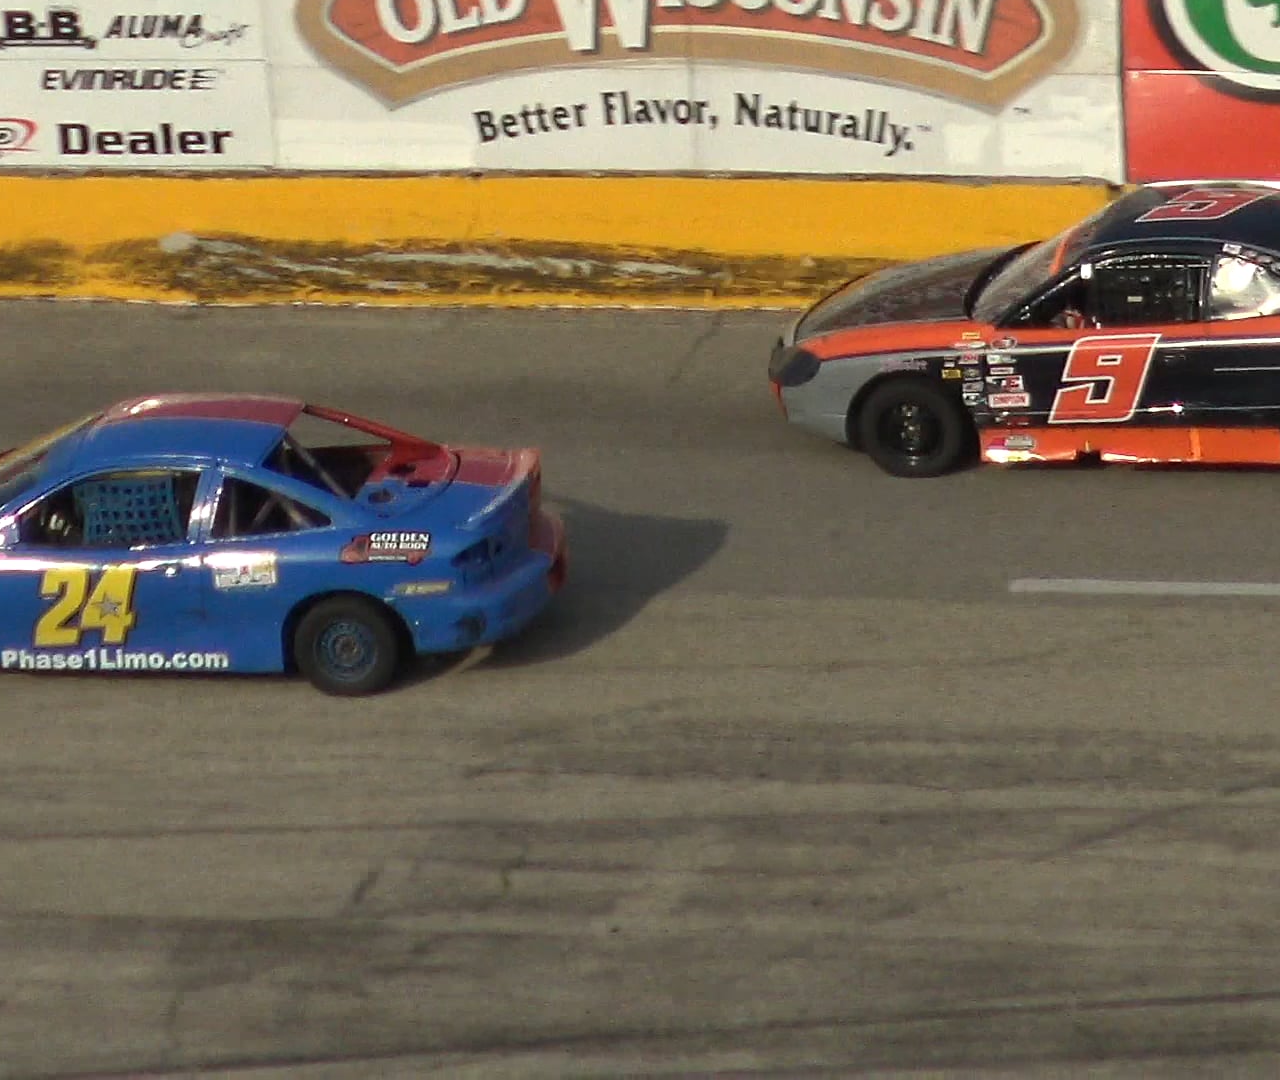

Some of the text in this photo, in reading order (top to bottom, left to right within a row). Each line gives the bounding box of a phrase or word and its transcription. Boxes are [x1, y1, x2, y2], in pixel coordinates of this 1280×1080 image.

[56, 123, 234, 156] Dealer
[472, 90, 915, 156] Better Flavor, Naturally.
[1047, 332, 1163, 425] 9
[33, 567, 138, 649] 24
[1, 648, 230, 670] Phase1Limo.com
